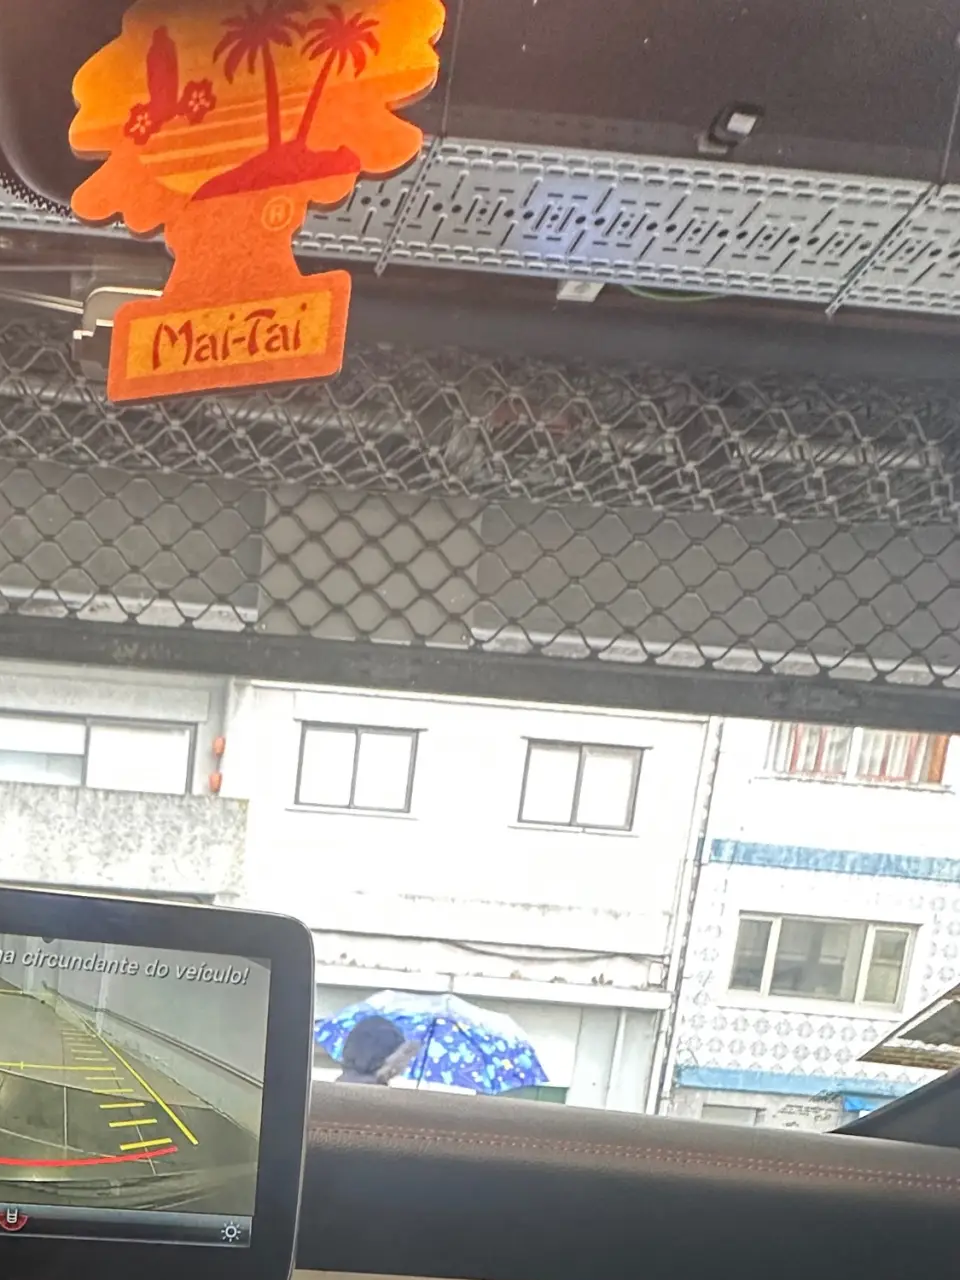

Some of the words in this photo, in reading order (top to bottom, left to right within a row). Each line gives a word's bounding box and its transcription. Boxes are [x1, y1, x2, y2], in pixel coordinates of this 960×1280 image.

[151, 302, 309, 371] Mai-Tai
[21, 948, 140, 976] circundante
[145, 959, 170, 979] do
[175, 963, 251, 986] veículo!
